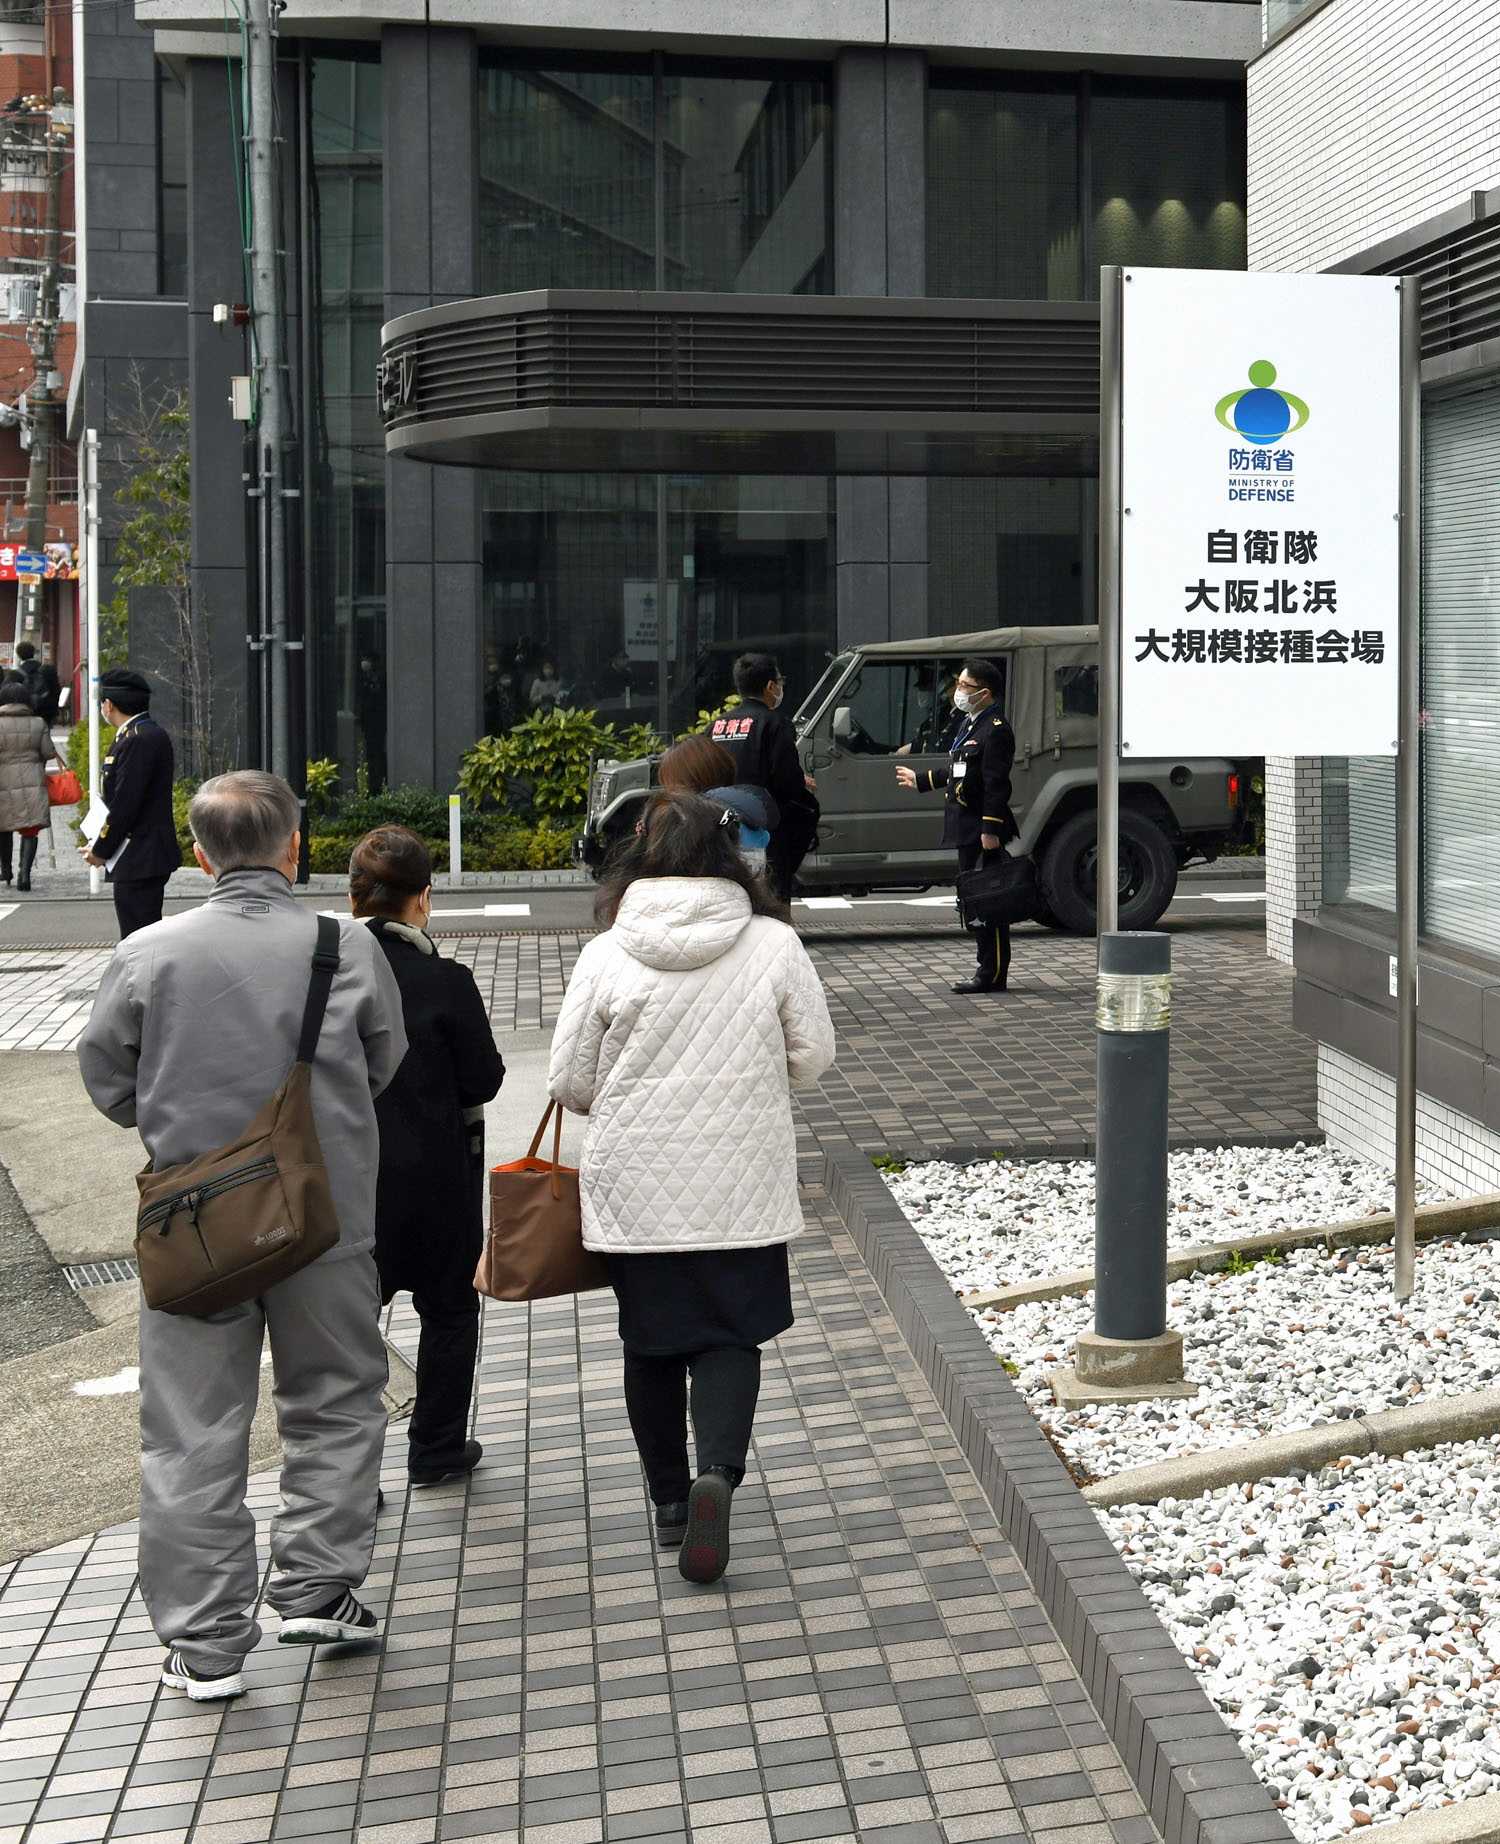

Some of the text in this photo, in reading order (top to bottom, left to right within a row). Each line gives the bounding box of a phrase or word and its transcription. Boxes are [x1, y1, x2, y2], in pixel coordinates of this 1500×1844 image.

[1229, 448, 1295, 471] 防衛省
[1229, 479, 1279, 487] MINISTRY
[1229, 488, 1295, 502] DEFENSE
[1207, 528, 1318, 565] 自衛隊
[1185, 579, 1337, 614] 大阪北浜
[1134, 628, 1385, 665] 大規模接種会場
[712, 718, 753, 734] 防衛省
[265, 1226, 286, 1240] LOGOS
